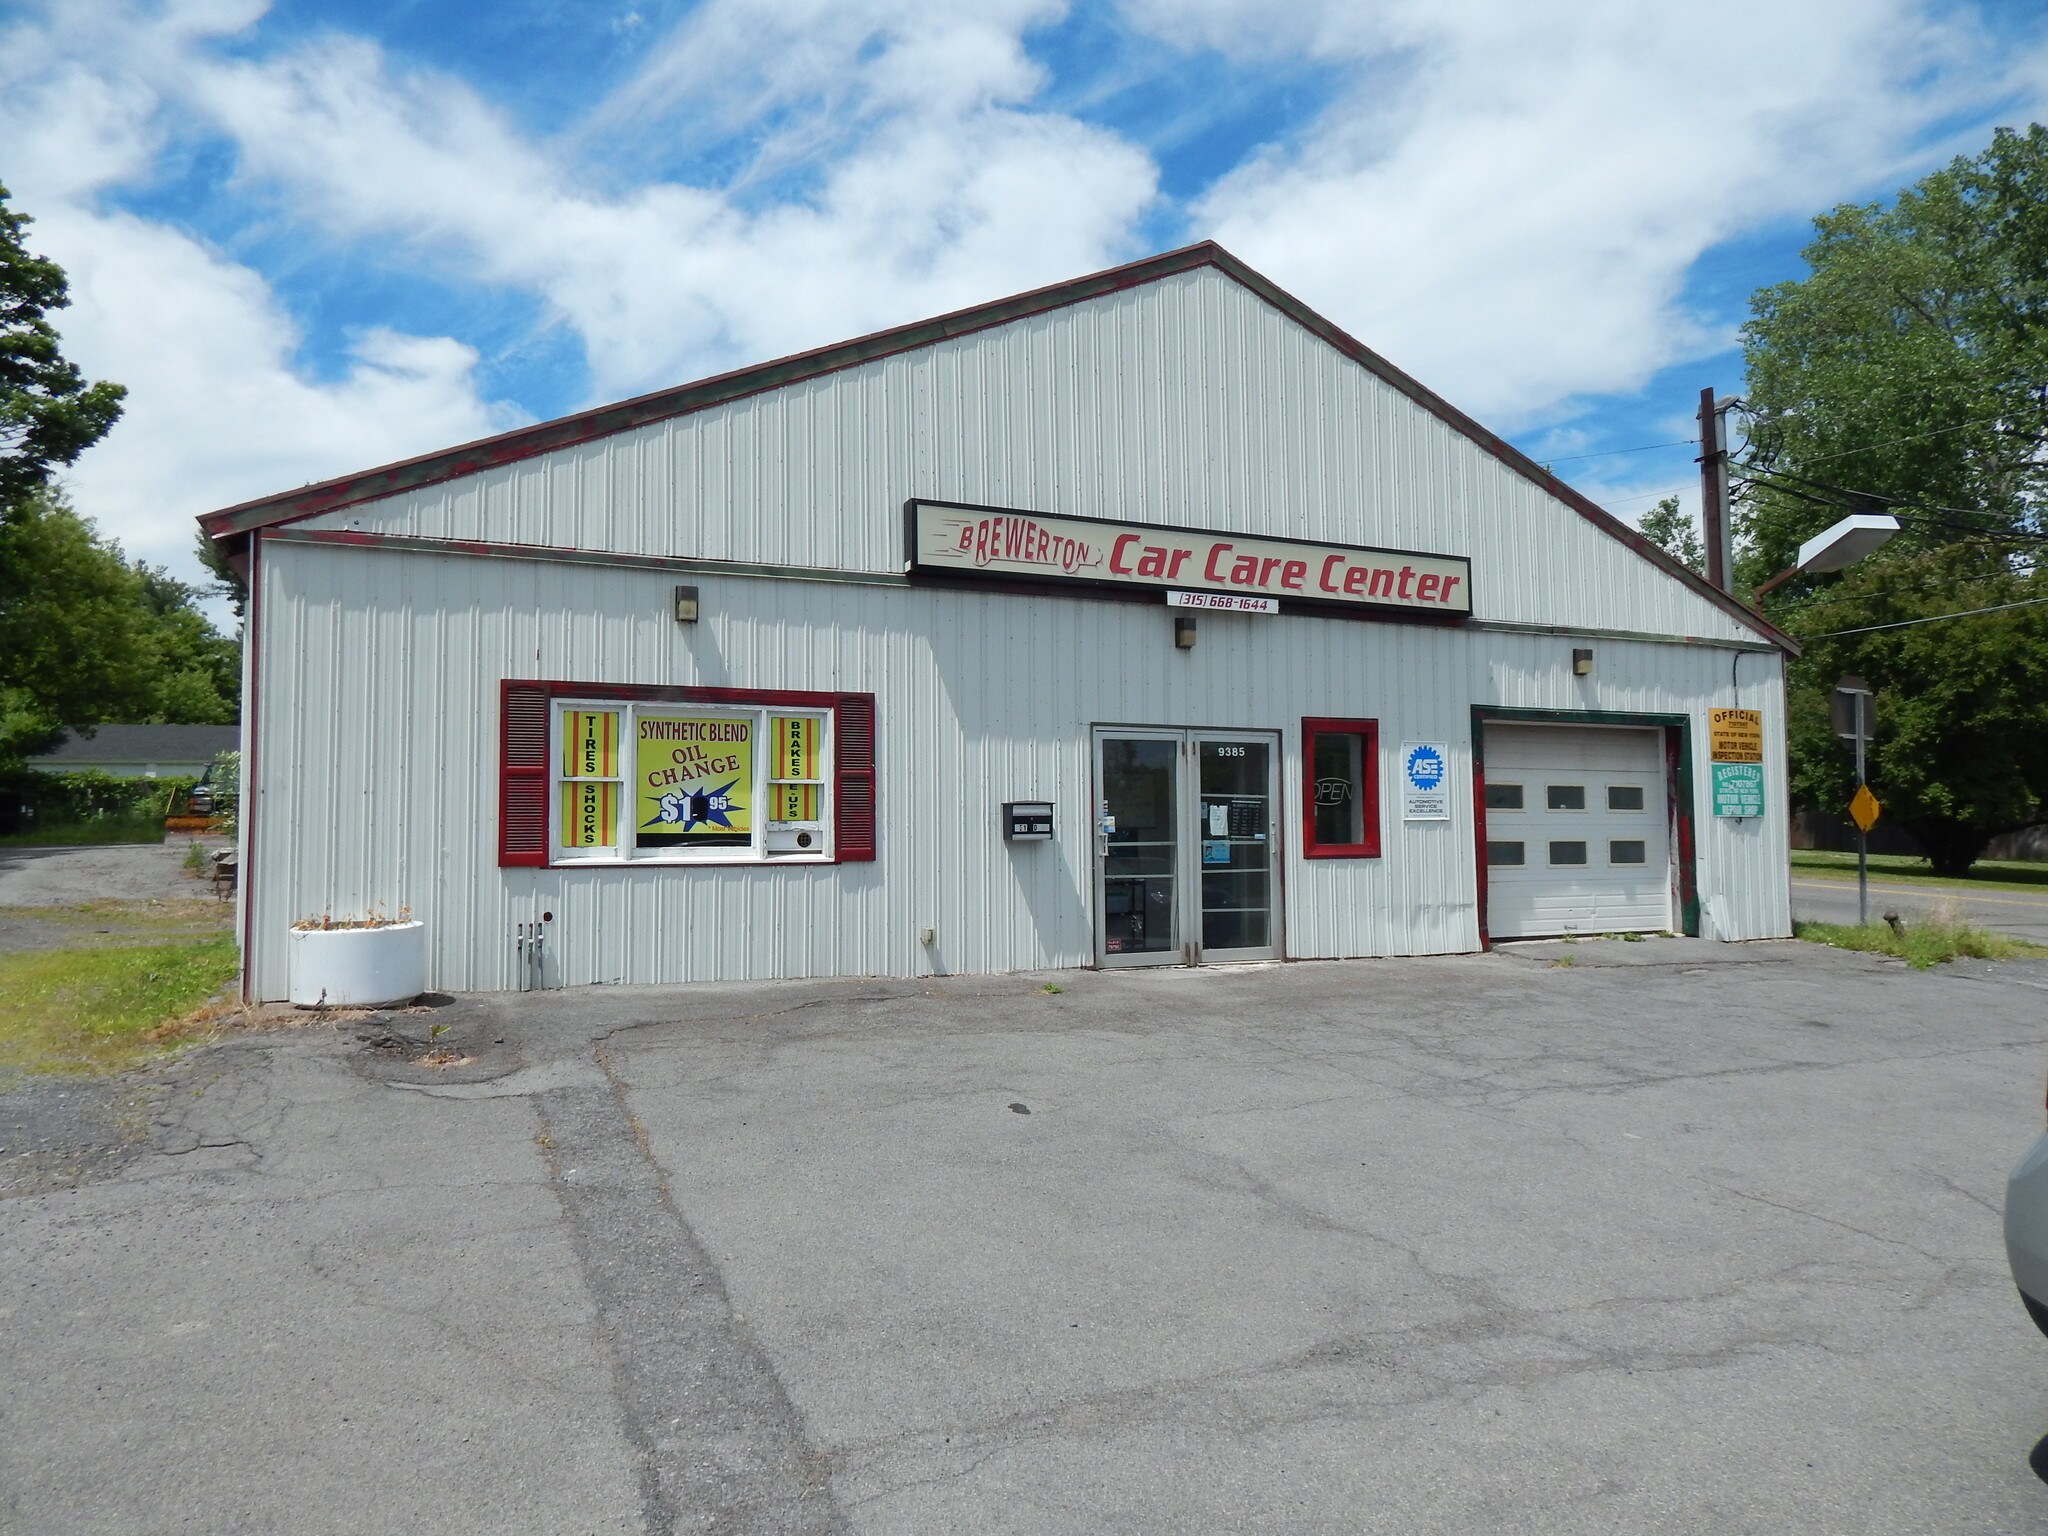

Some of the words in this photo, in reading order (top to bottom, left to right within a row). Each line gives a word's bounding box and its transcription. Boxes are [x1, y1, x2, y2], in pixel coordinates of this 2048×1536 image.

[959, 517, 1090, 570] BREWERTON
[1109, 533, 1193, 579] Car
[1204, 543, 1307, 589] Care
[1319, 554, 1461, 603] Center
[1179, 593, 1208, 607] (315)
[1209, 596, 1268, 611] 668-1644
[1714, 710, 1759, 725] OFFICIAL
[640, 720, 707, 741] SYNTHETIC
[709, 723, 748, 742] BLEND
[585, 716, 597, 773] TIRES
[790, 721, 801, 776] BRAKES
[1218, 747, 1245, 757] 9385
[1718, 741, 1738, 750] MOTOR
[1739, 742, 1758, 751] VEHICLE
[671, 745, 707, 765] OIL
[1712, 751, 1743, 760] INSPECTION
[648, 755, 740, 788] CHANGE
[1411, 758, 1438, 774] ASE
[1717, 766, 1761, 782] REGISTERED
[1314, 783, 1354, 800] OPEN
[1717, 794, 1739, 804] MOTOR
[1740, 795, 1761, 804] VEHICLE
[584, 785, 596, 843] SHOCKS
